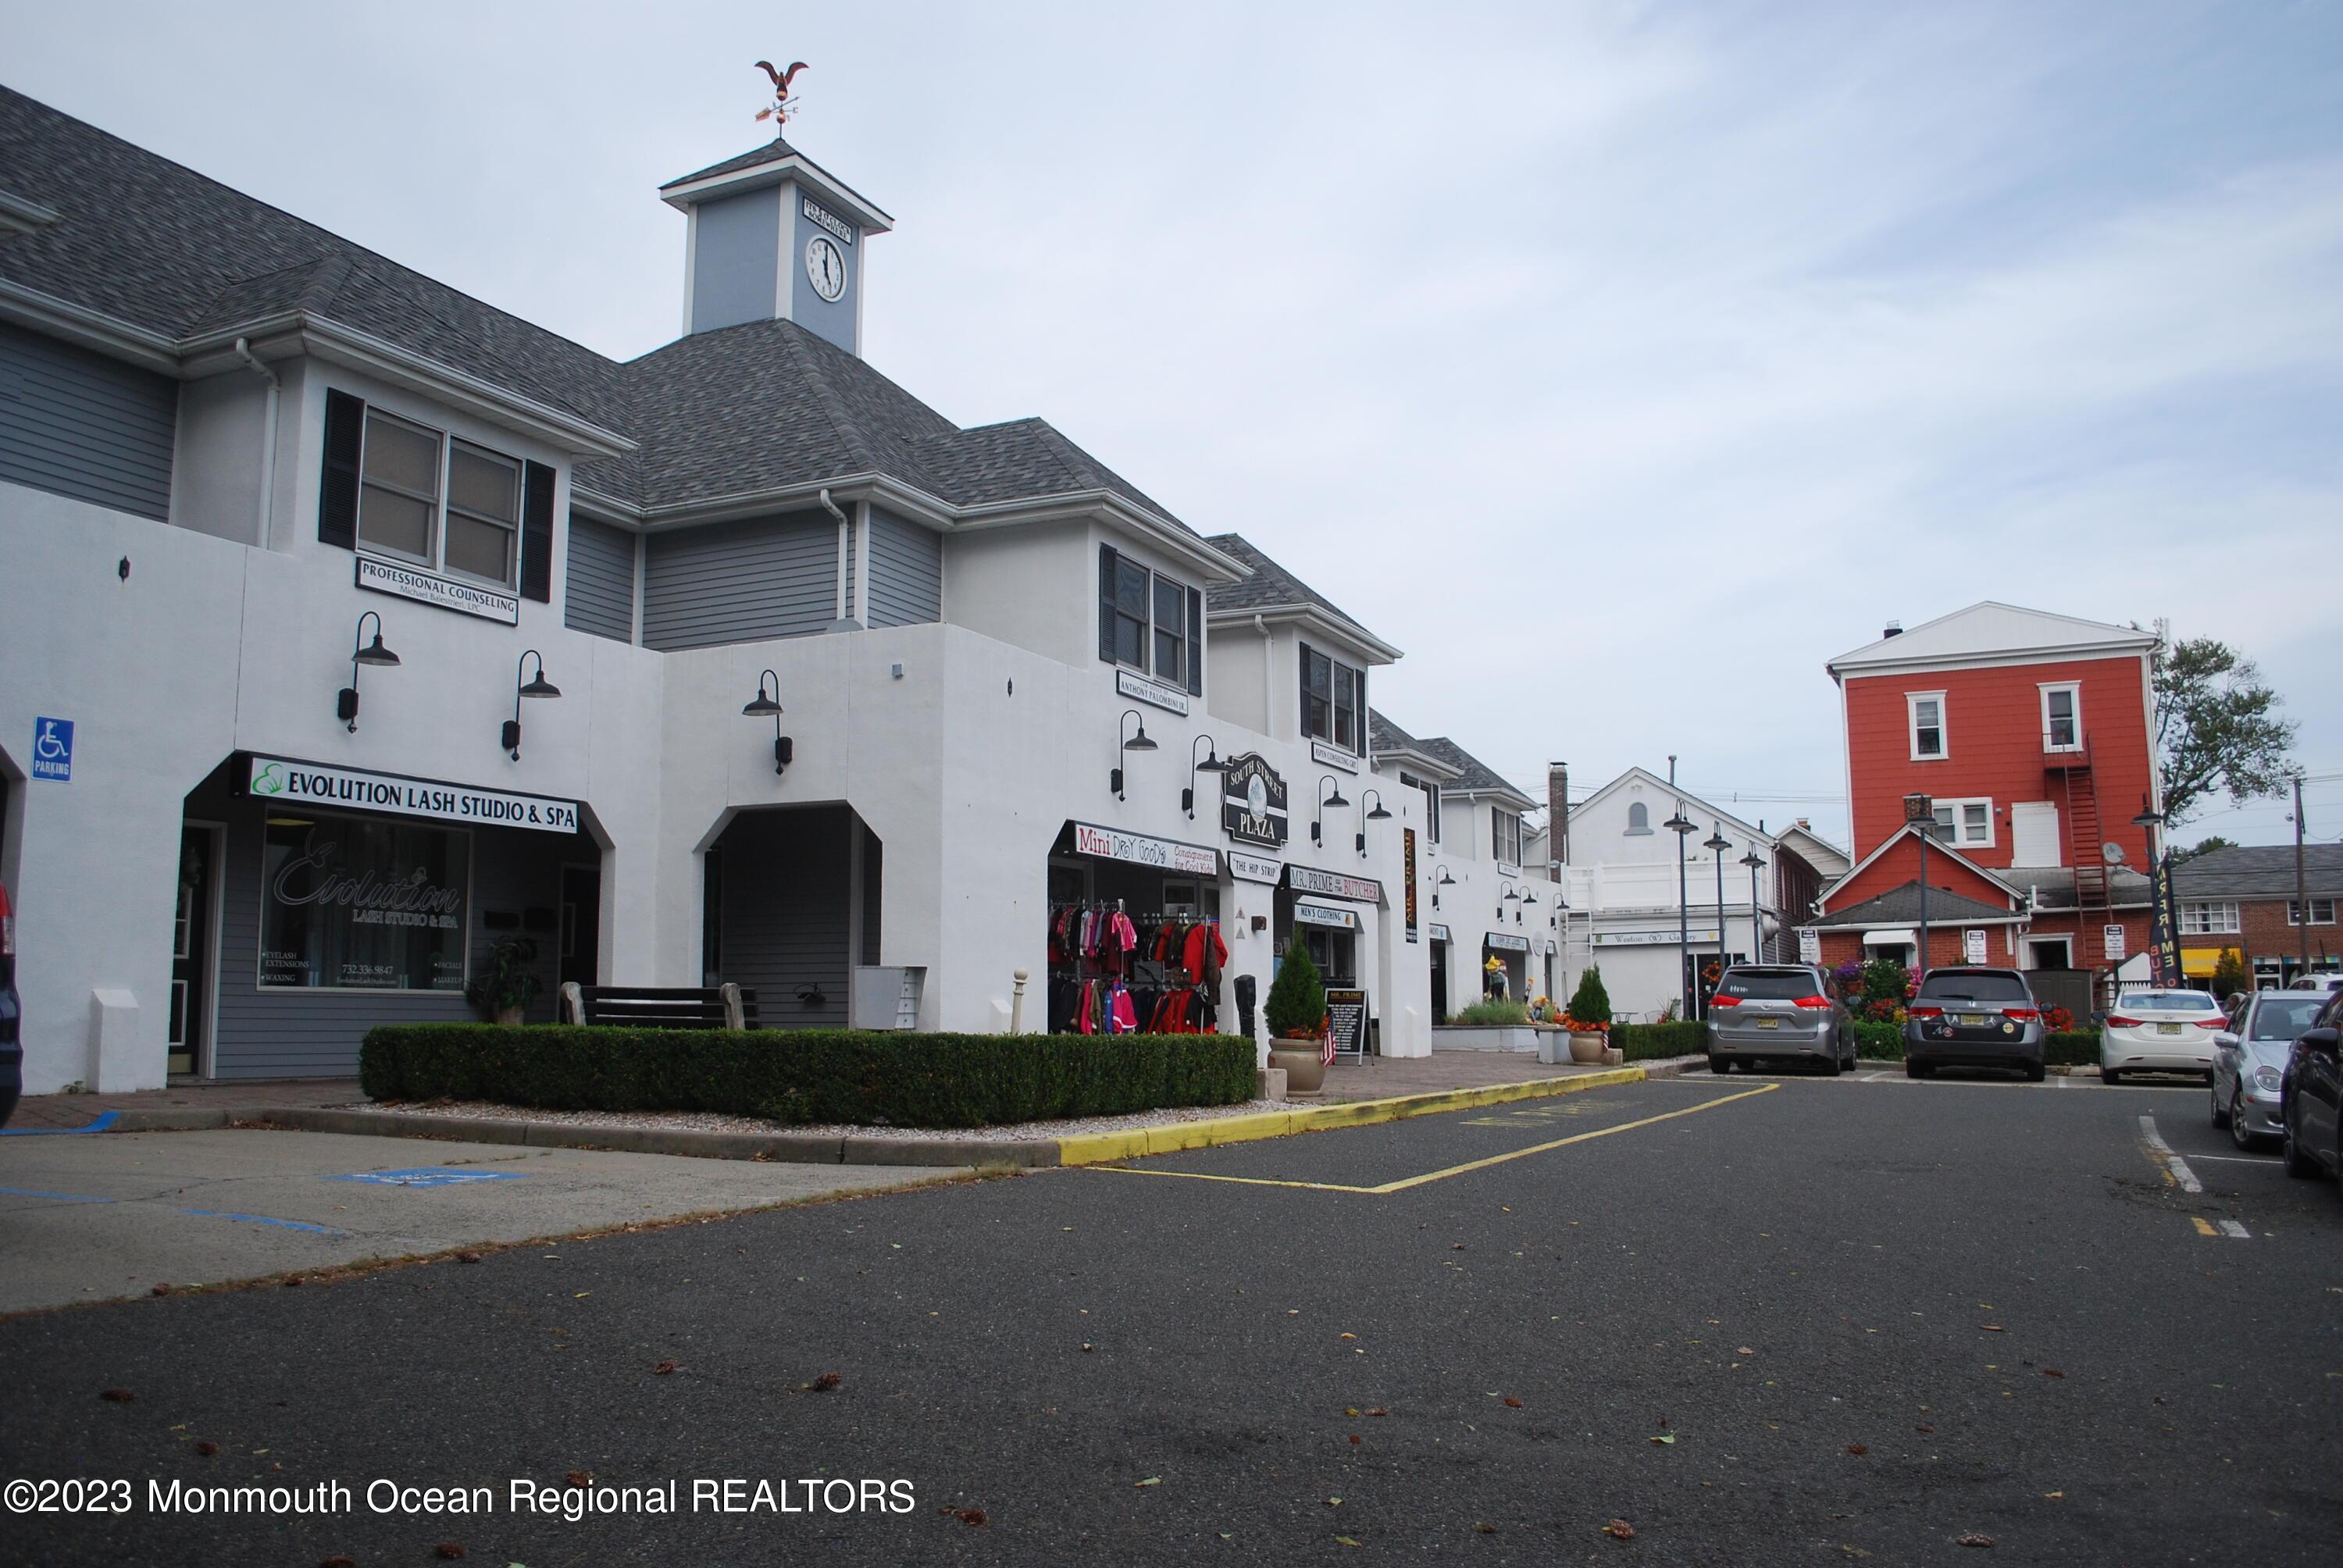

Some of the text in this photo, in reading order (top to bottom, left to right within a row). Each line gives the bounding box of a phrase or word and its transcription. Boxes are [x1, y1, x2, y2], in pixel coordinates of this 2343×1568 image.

[362, 562, 515, 612] PROFESSIONAL COUNSELING
[399, 585, 428, 600] Michael
[468, 604, 481, 613] LPC
[1121, 680, 1148, 697] ANTHONY
[1149, 691, 1178, 708] PALOMBINI
[34, 760, 70, 775] PARKING
[1230, 761, 1282, 799] SOUTH STREET
[288, 771, 576, 828] EVOLUTION LASH STUDIO & SPA
[1239, 812, 1275, 839] PLAZA
[1079, 827, 1111, 856] Mini
[1112, 835, 1137, 859] DRY
[1174, 845, 1214, 864] Consignment
[274, 826, 460, 913] Evolution
[1174, 858, 1214, 875] for Cool Kids
[1249, 864, 1259, 874] HIP
[1291, 868, 1333, 893] MR. PRIME
[1343, 878, 1378, 900] BUTCHER
[352, 908, 458, 928] LASH STUDIO & SPA
[1300, 906, 1341, 921] MEN'S CLOTHING
[1614, 935, 1642, 943] Weston
[266, 951, 297, 960] EYELASH
[266, 960, 309, 968] EXTENSIONS
[266, 974, 296, 982] WAXING
[342, 964, 394, 975] 732.336.9847
